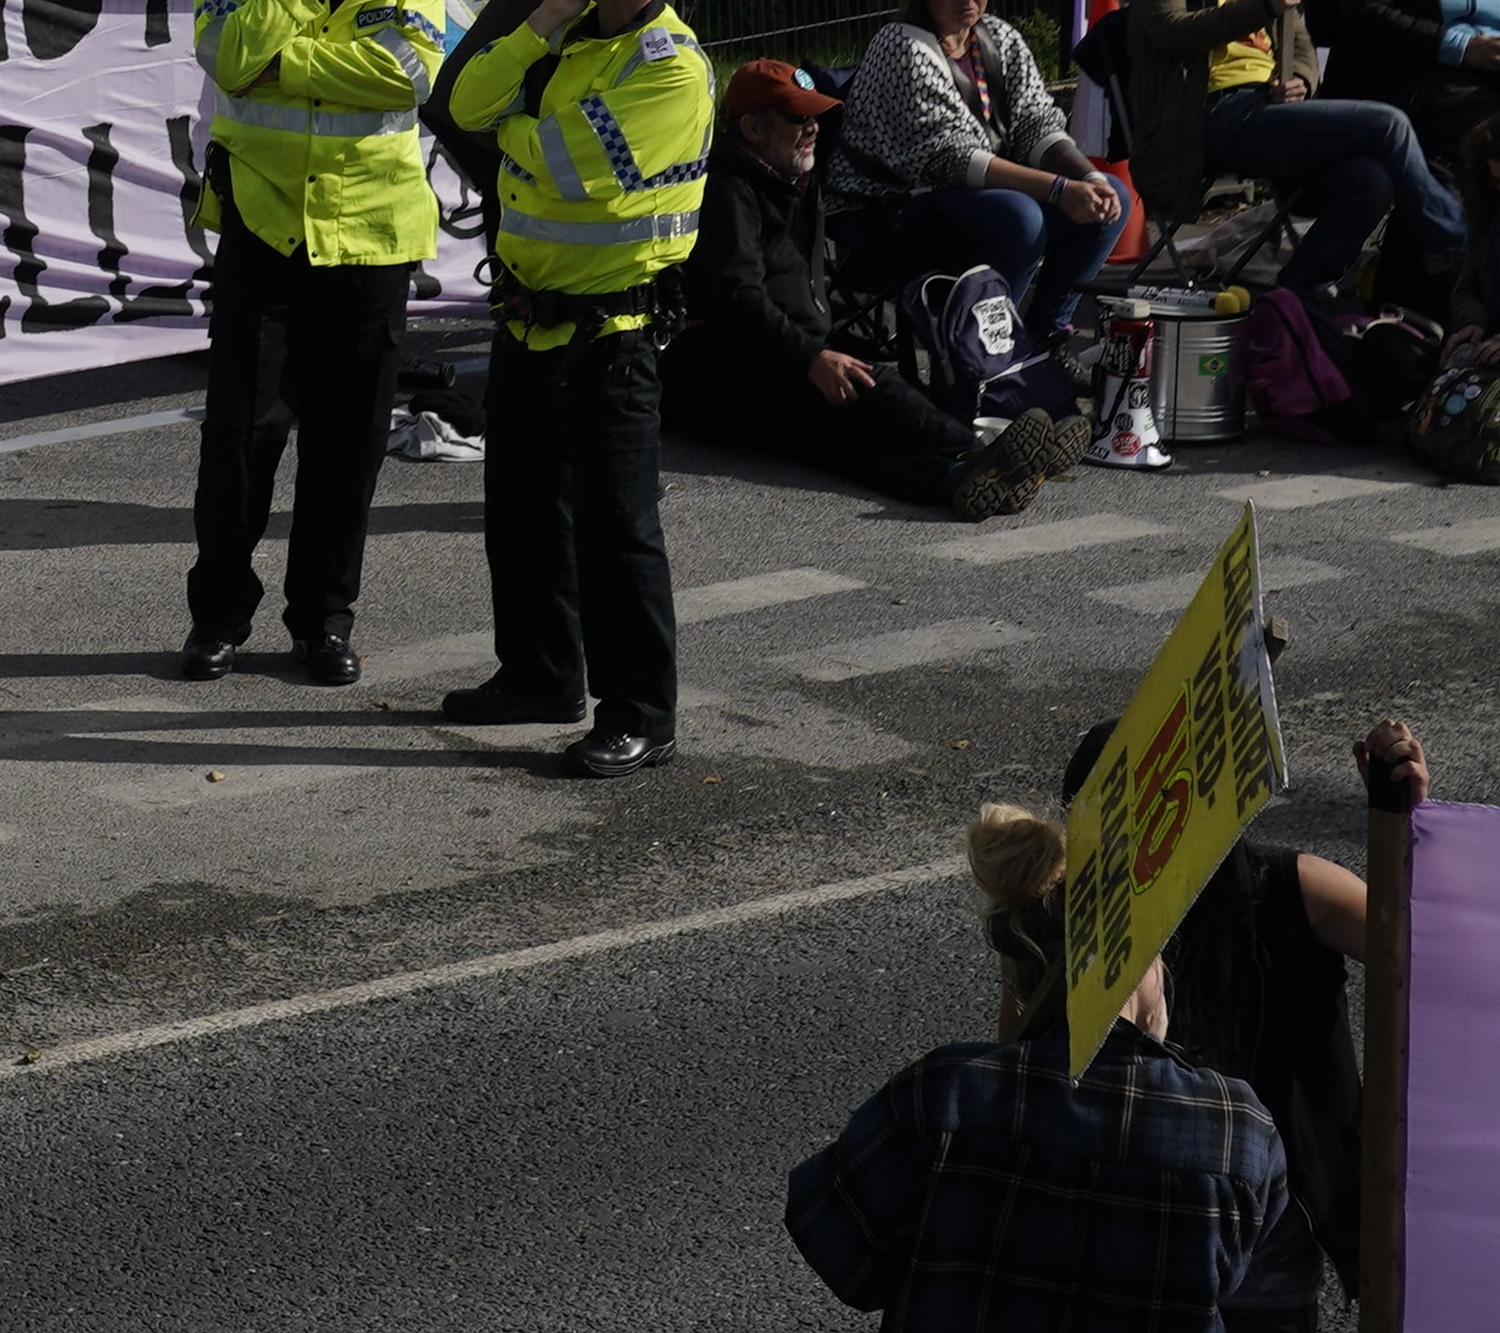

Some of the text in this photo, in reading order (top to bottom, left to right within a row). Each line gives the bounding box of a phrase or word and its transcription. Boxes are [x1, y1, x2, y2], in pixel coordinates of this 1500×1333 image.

[1100, 743, 1133, 993] FRACKING
[1130, 679, 1194, 895] NO
[1068, 845, 1100, 993] HERE
